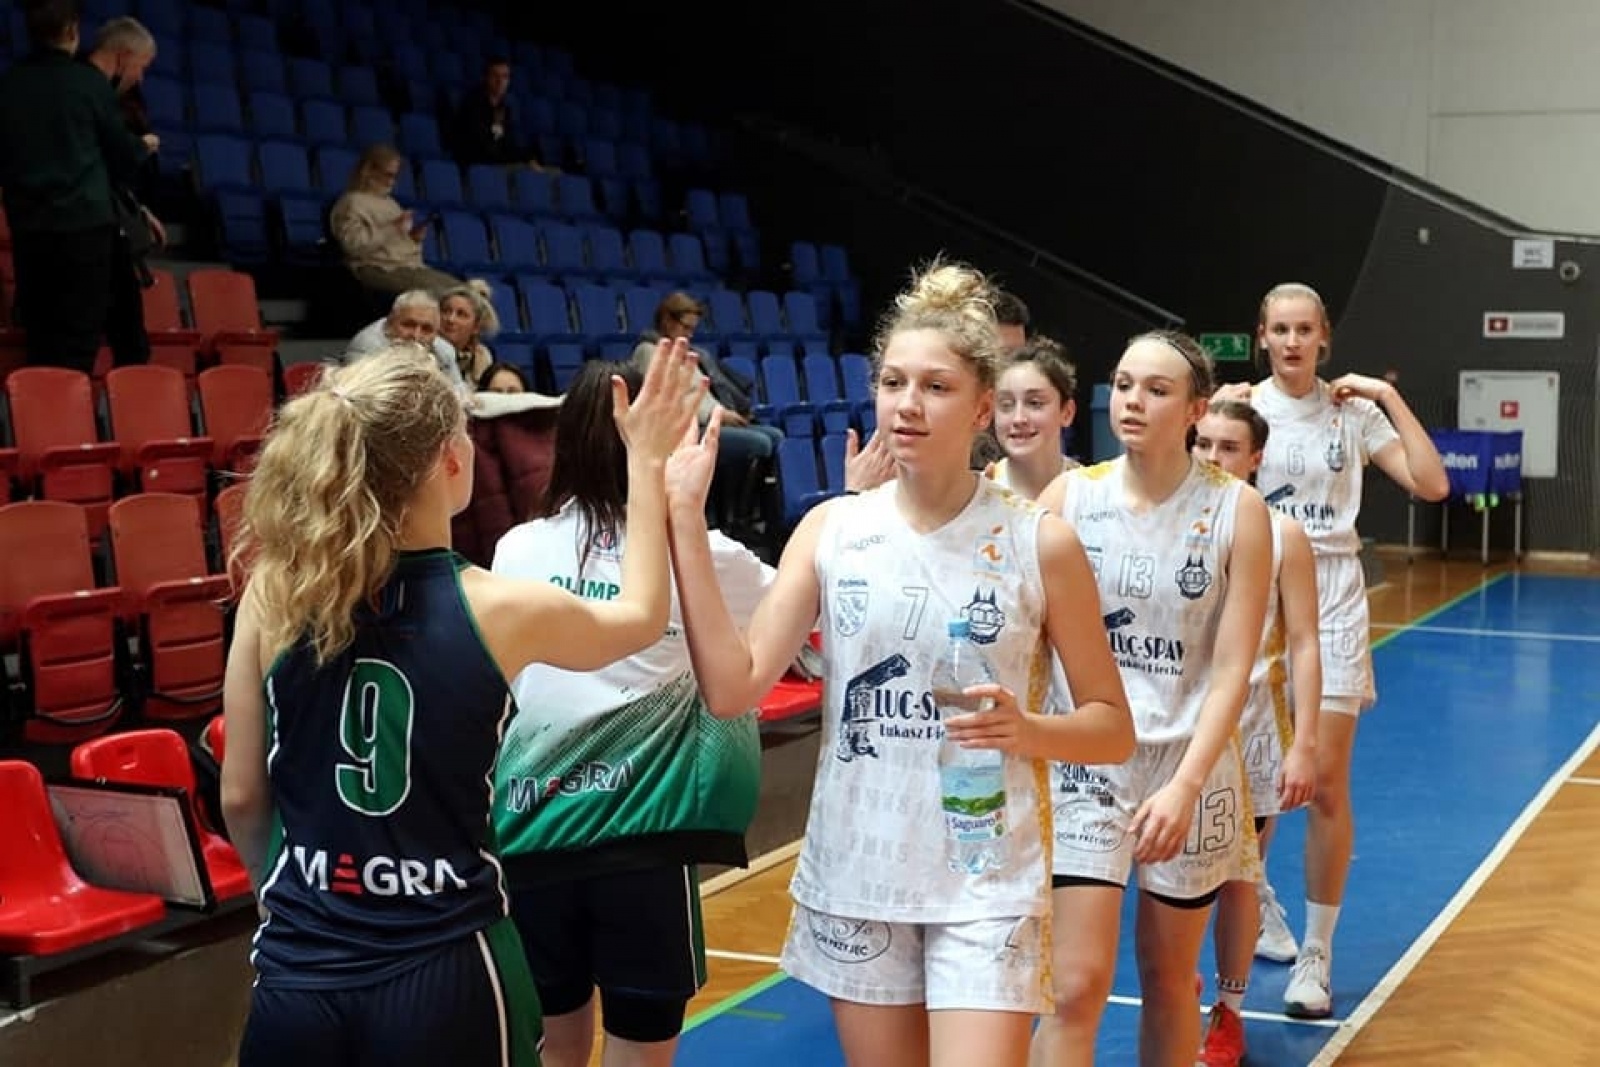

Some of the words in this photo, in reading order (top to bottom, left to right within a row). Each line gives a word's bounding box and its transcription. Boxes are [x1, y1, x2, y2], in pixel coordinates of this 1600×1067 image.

[1119, 553, 1155, 598] 13
[902, 586, 928, 640] 7
[334, 657, 415, 816] 9
[1246, 733, 1278, 782] 4
[1184, 786, 1237, 856] 13
